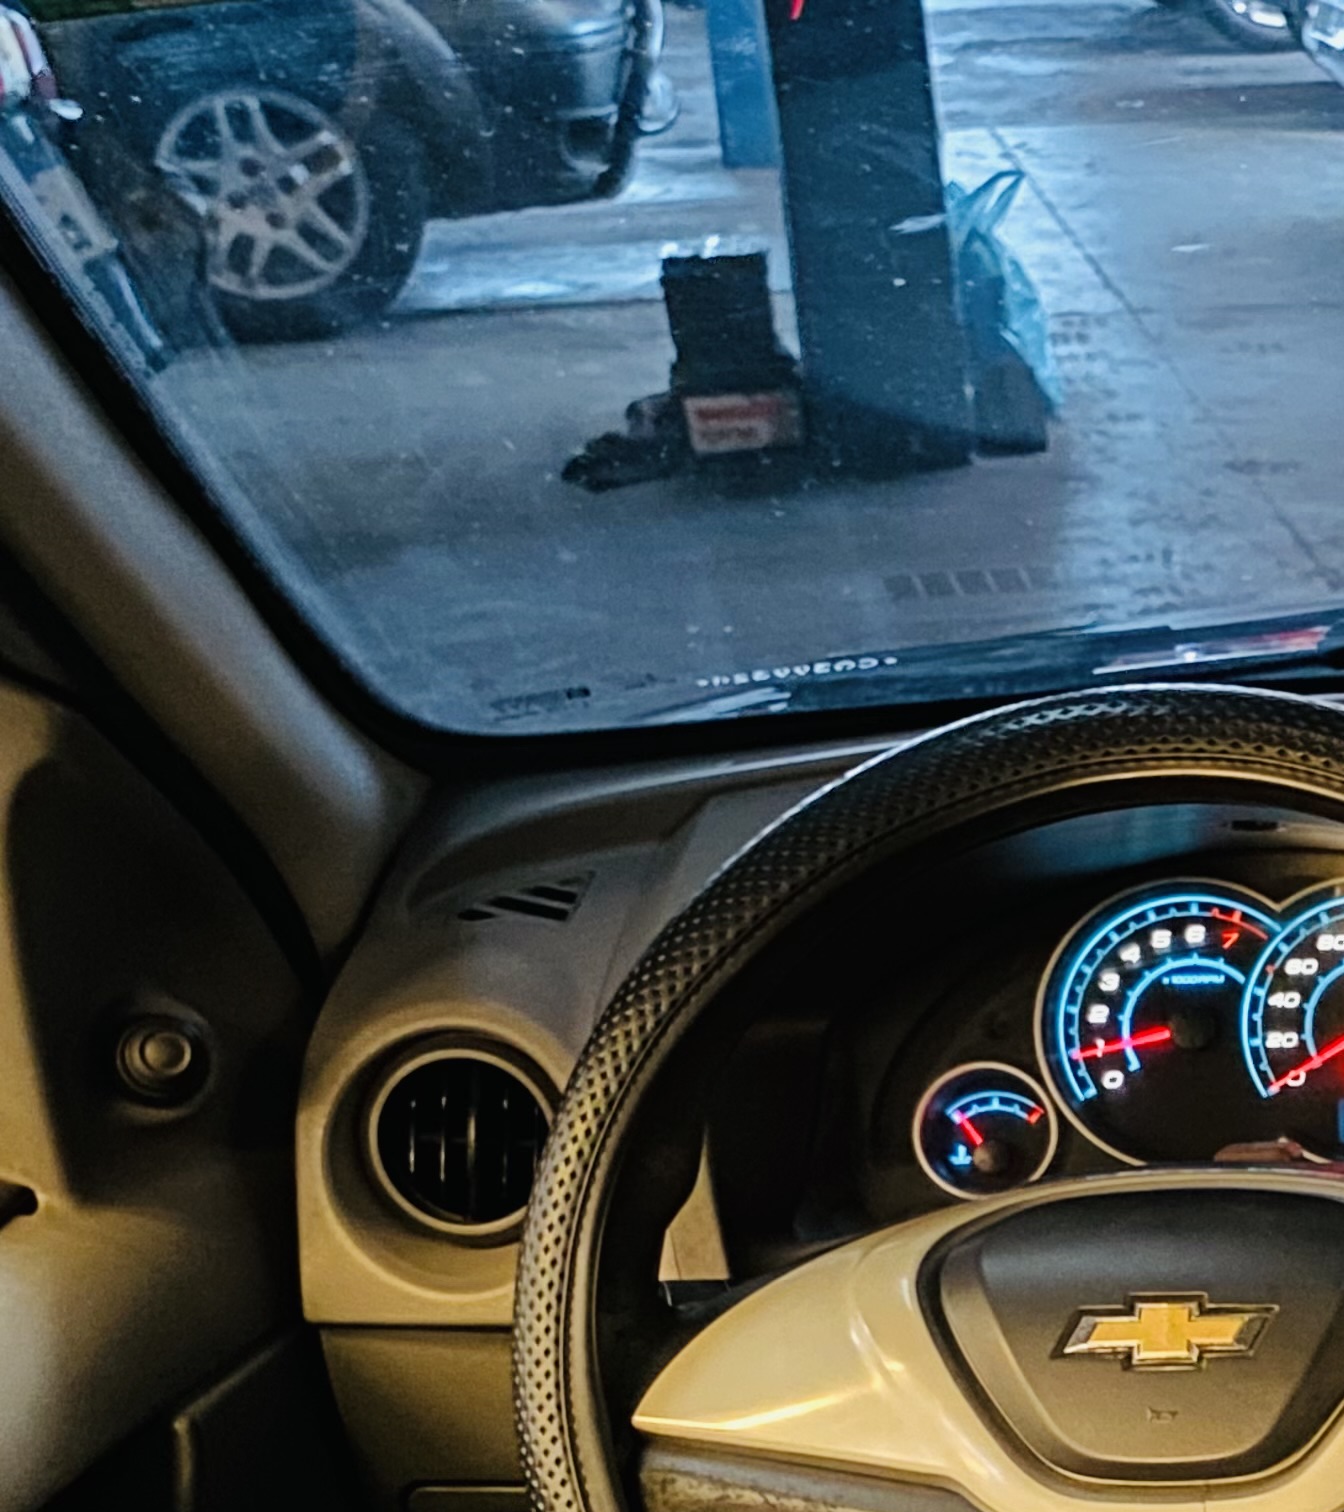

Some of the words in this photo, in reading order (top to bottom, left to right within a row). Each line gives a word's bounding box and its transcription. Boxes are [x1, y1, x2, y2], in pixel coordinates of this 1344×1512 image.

[1221, 930, 1241, 949] 7
[1119, 943, 1141, 964] 4
[1267, 992, 1301, 1009] 40
[1265, 1031, 1299, 1049] 20
[1101, 1069, 1125, 1090] 0
